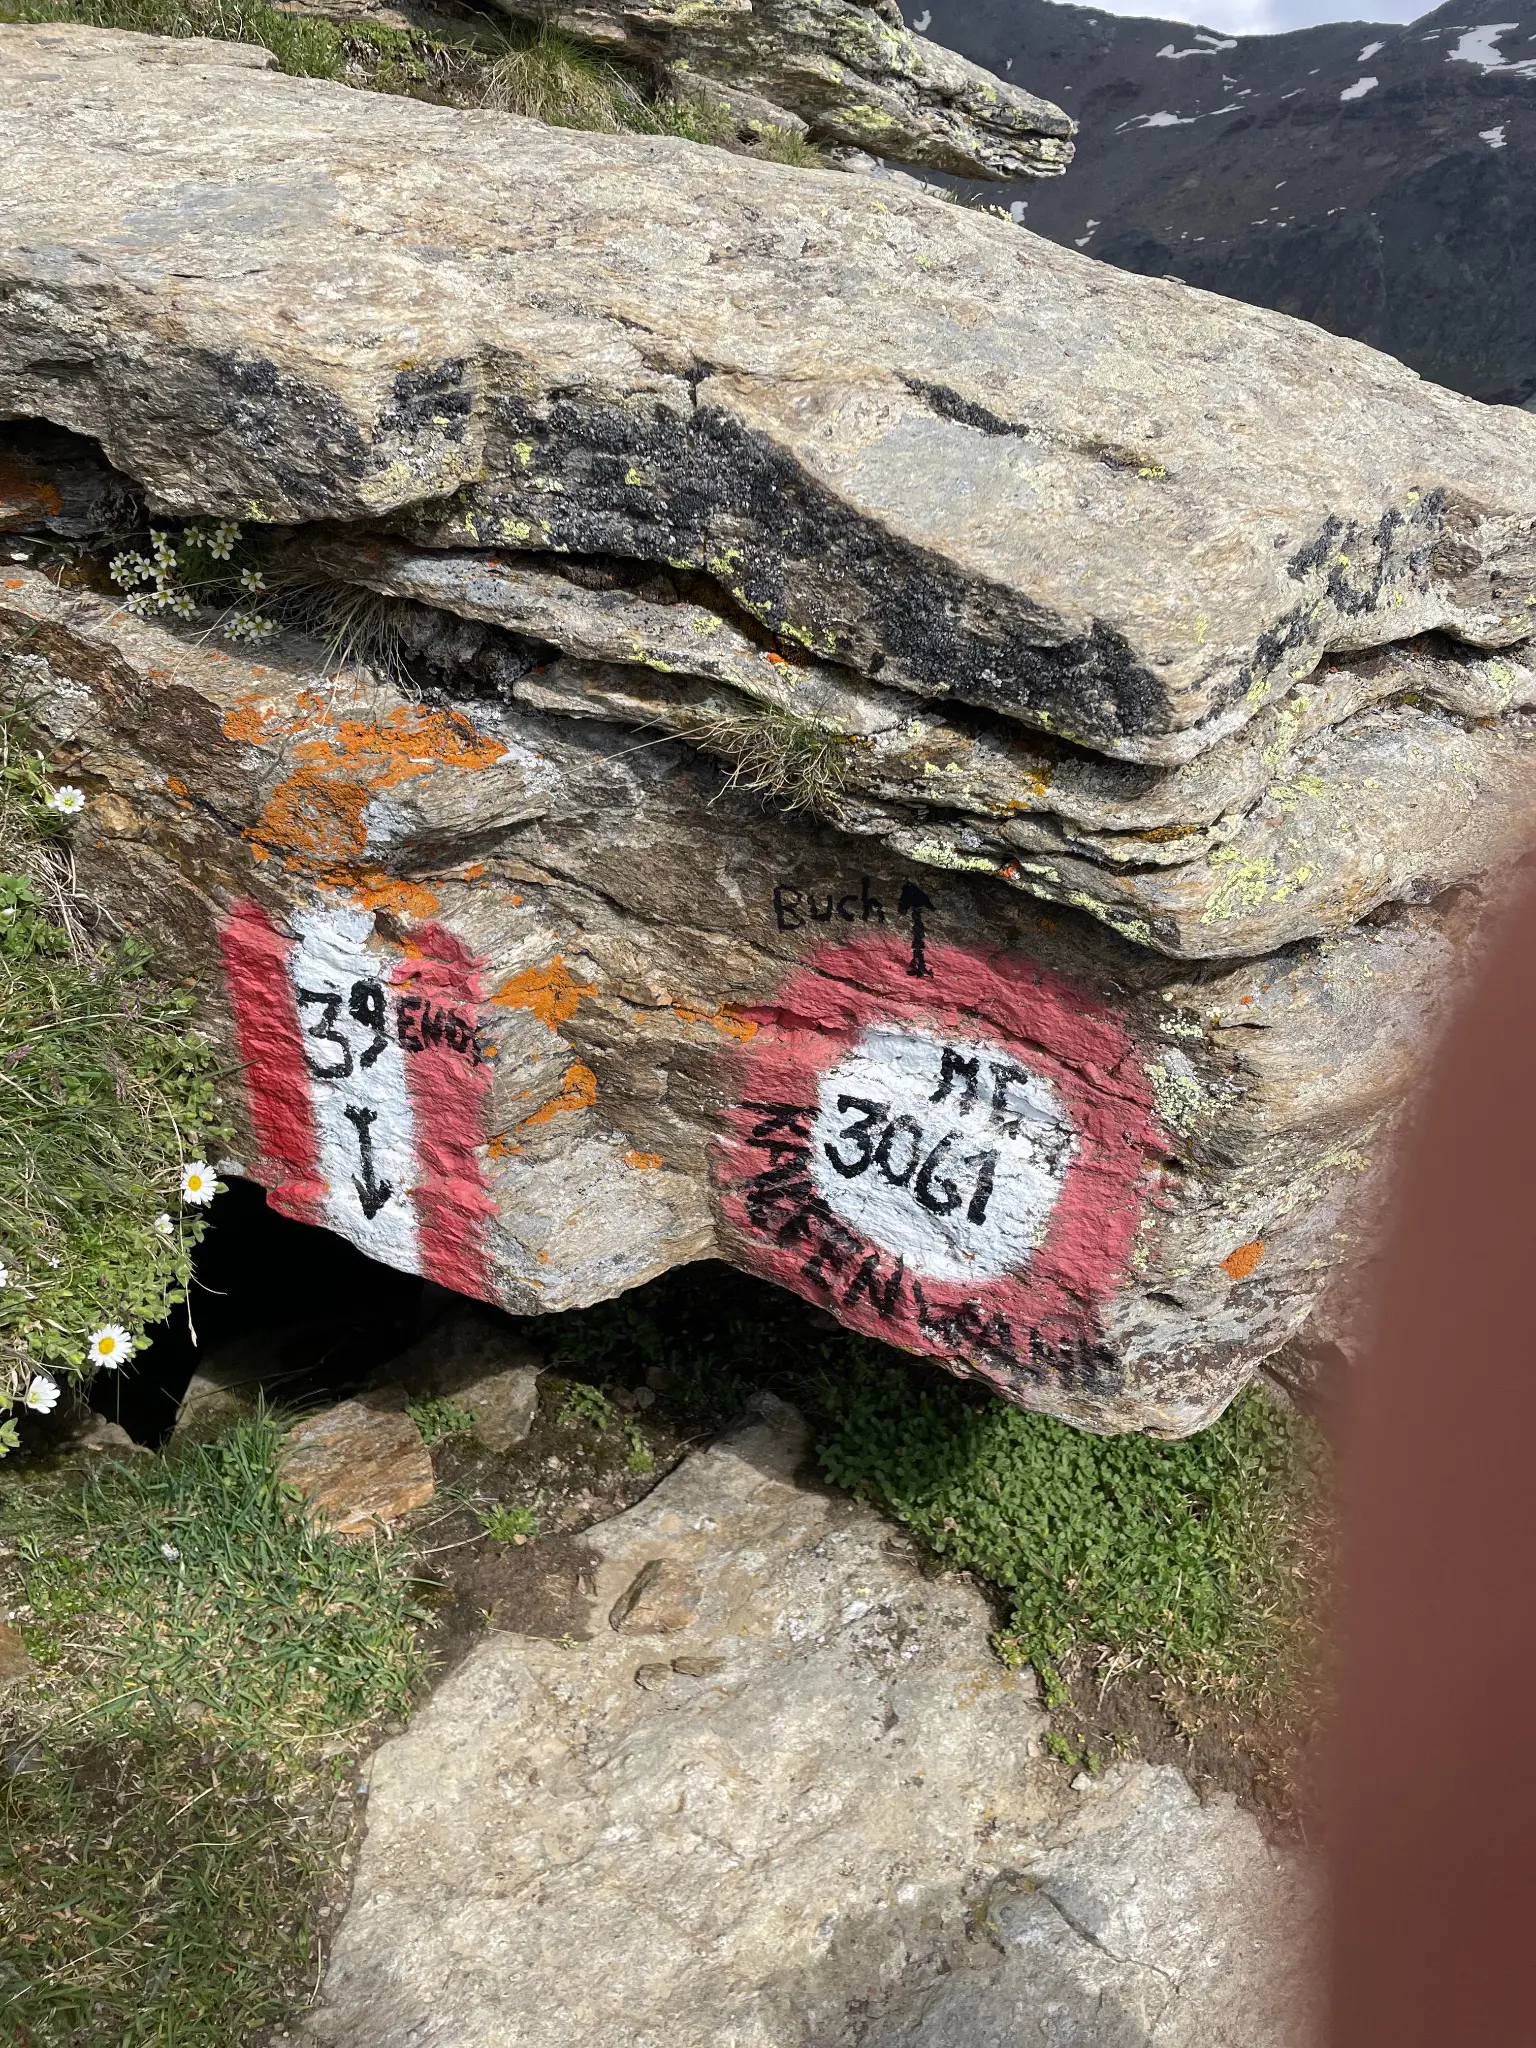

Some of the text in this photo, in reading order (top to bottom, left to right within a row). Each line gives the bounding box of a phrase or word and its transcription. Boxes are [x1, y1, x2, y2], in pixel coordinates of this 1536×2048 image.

[774, 876, 885, 932] Buch
[298, 977, 388, 1078] 39
[825, 1095, 999, 1226] 3061
